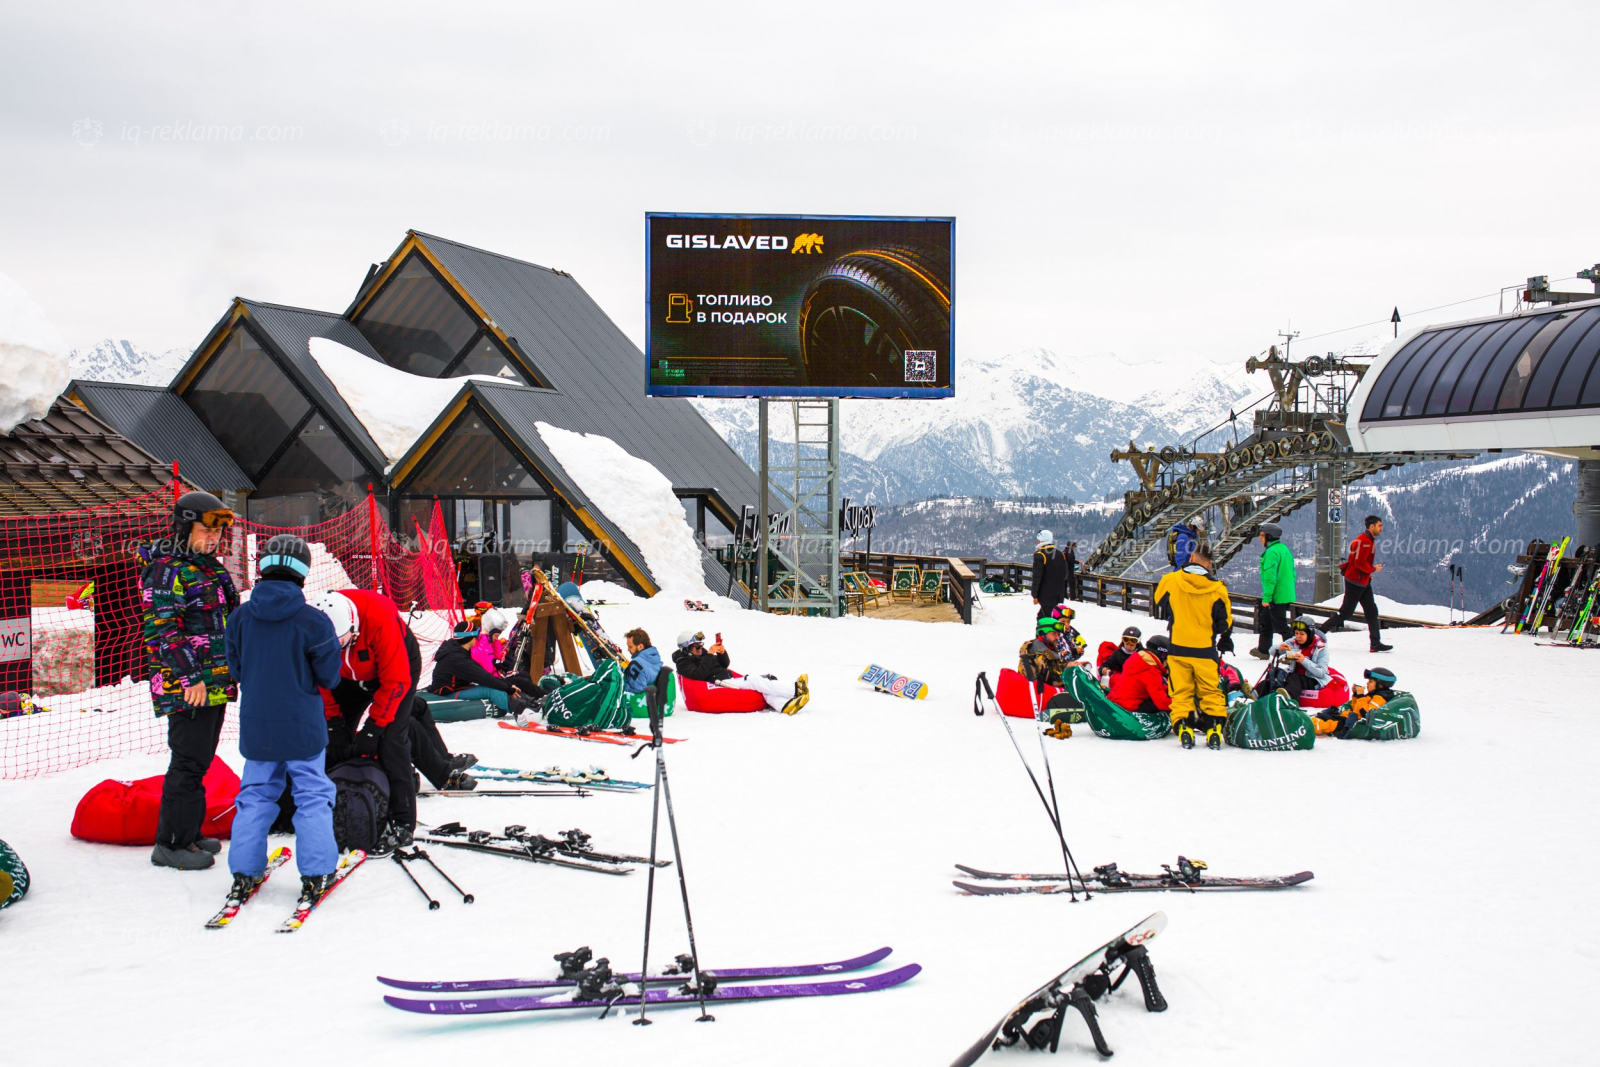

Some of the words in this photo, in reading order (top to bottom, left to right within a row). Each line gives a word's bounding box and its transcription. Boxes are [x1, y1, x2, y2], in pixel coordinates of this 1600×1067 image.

[665, 234, 789, 250] GISLAVED
[696, 293, 773, 307] ТОПЛИВО
[696, 311, 707, 323] В
[710, 311, 788, 325] ПОДАРОК
[1, 631, 25, 648] WC
[1247, 725, 1307, 749] HUNTING
